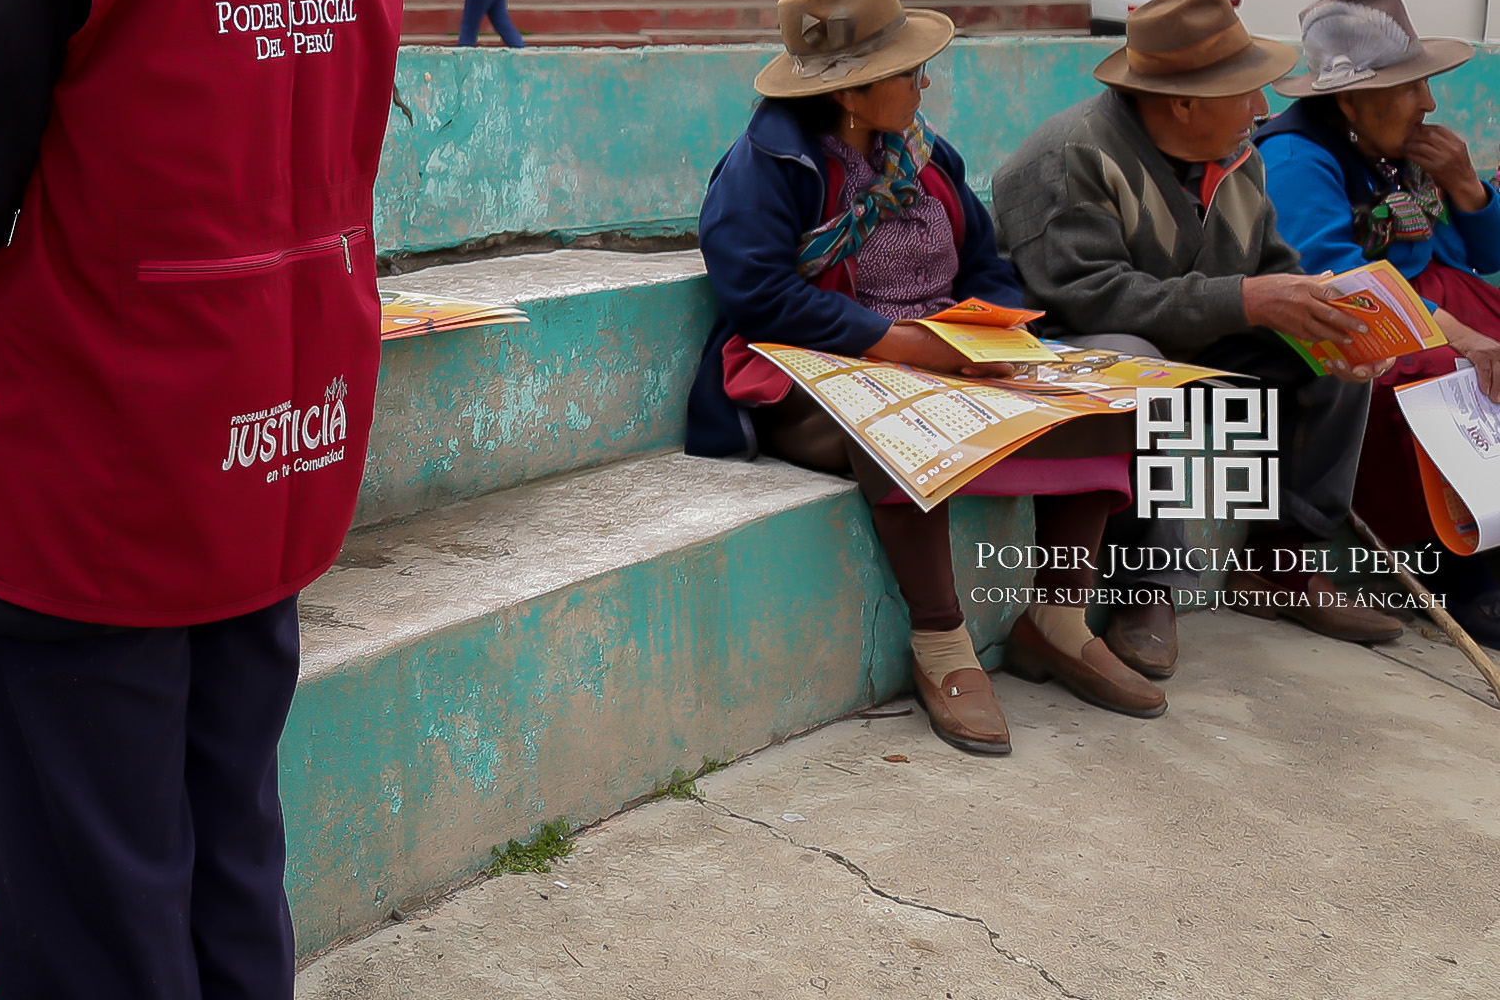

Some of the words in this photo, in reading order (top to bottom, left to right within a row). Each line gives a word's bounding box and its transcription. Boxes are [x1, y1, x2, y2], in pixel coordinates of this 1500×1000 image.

[215, 0, 287, 34] PODER
[255, 35, 286, 61] DEL
[293, 29, 334, 54] PERÚ
[222, 399, 348, 471] JUSTICIA
[266, 468, 279, 483] en
[293, 445, 345, 473] Comunidad
